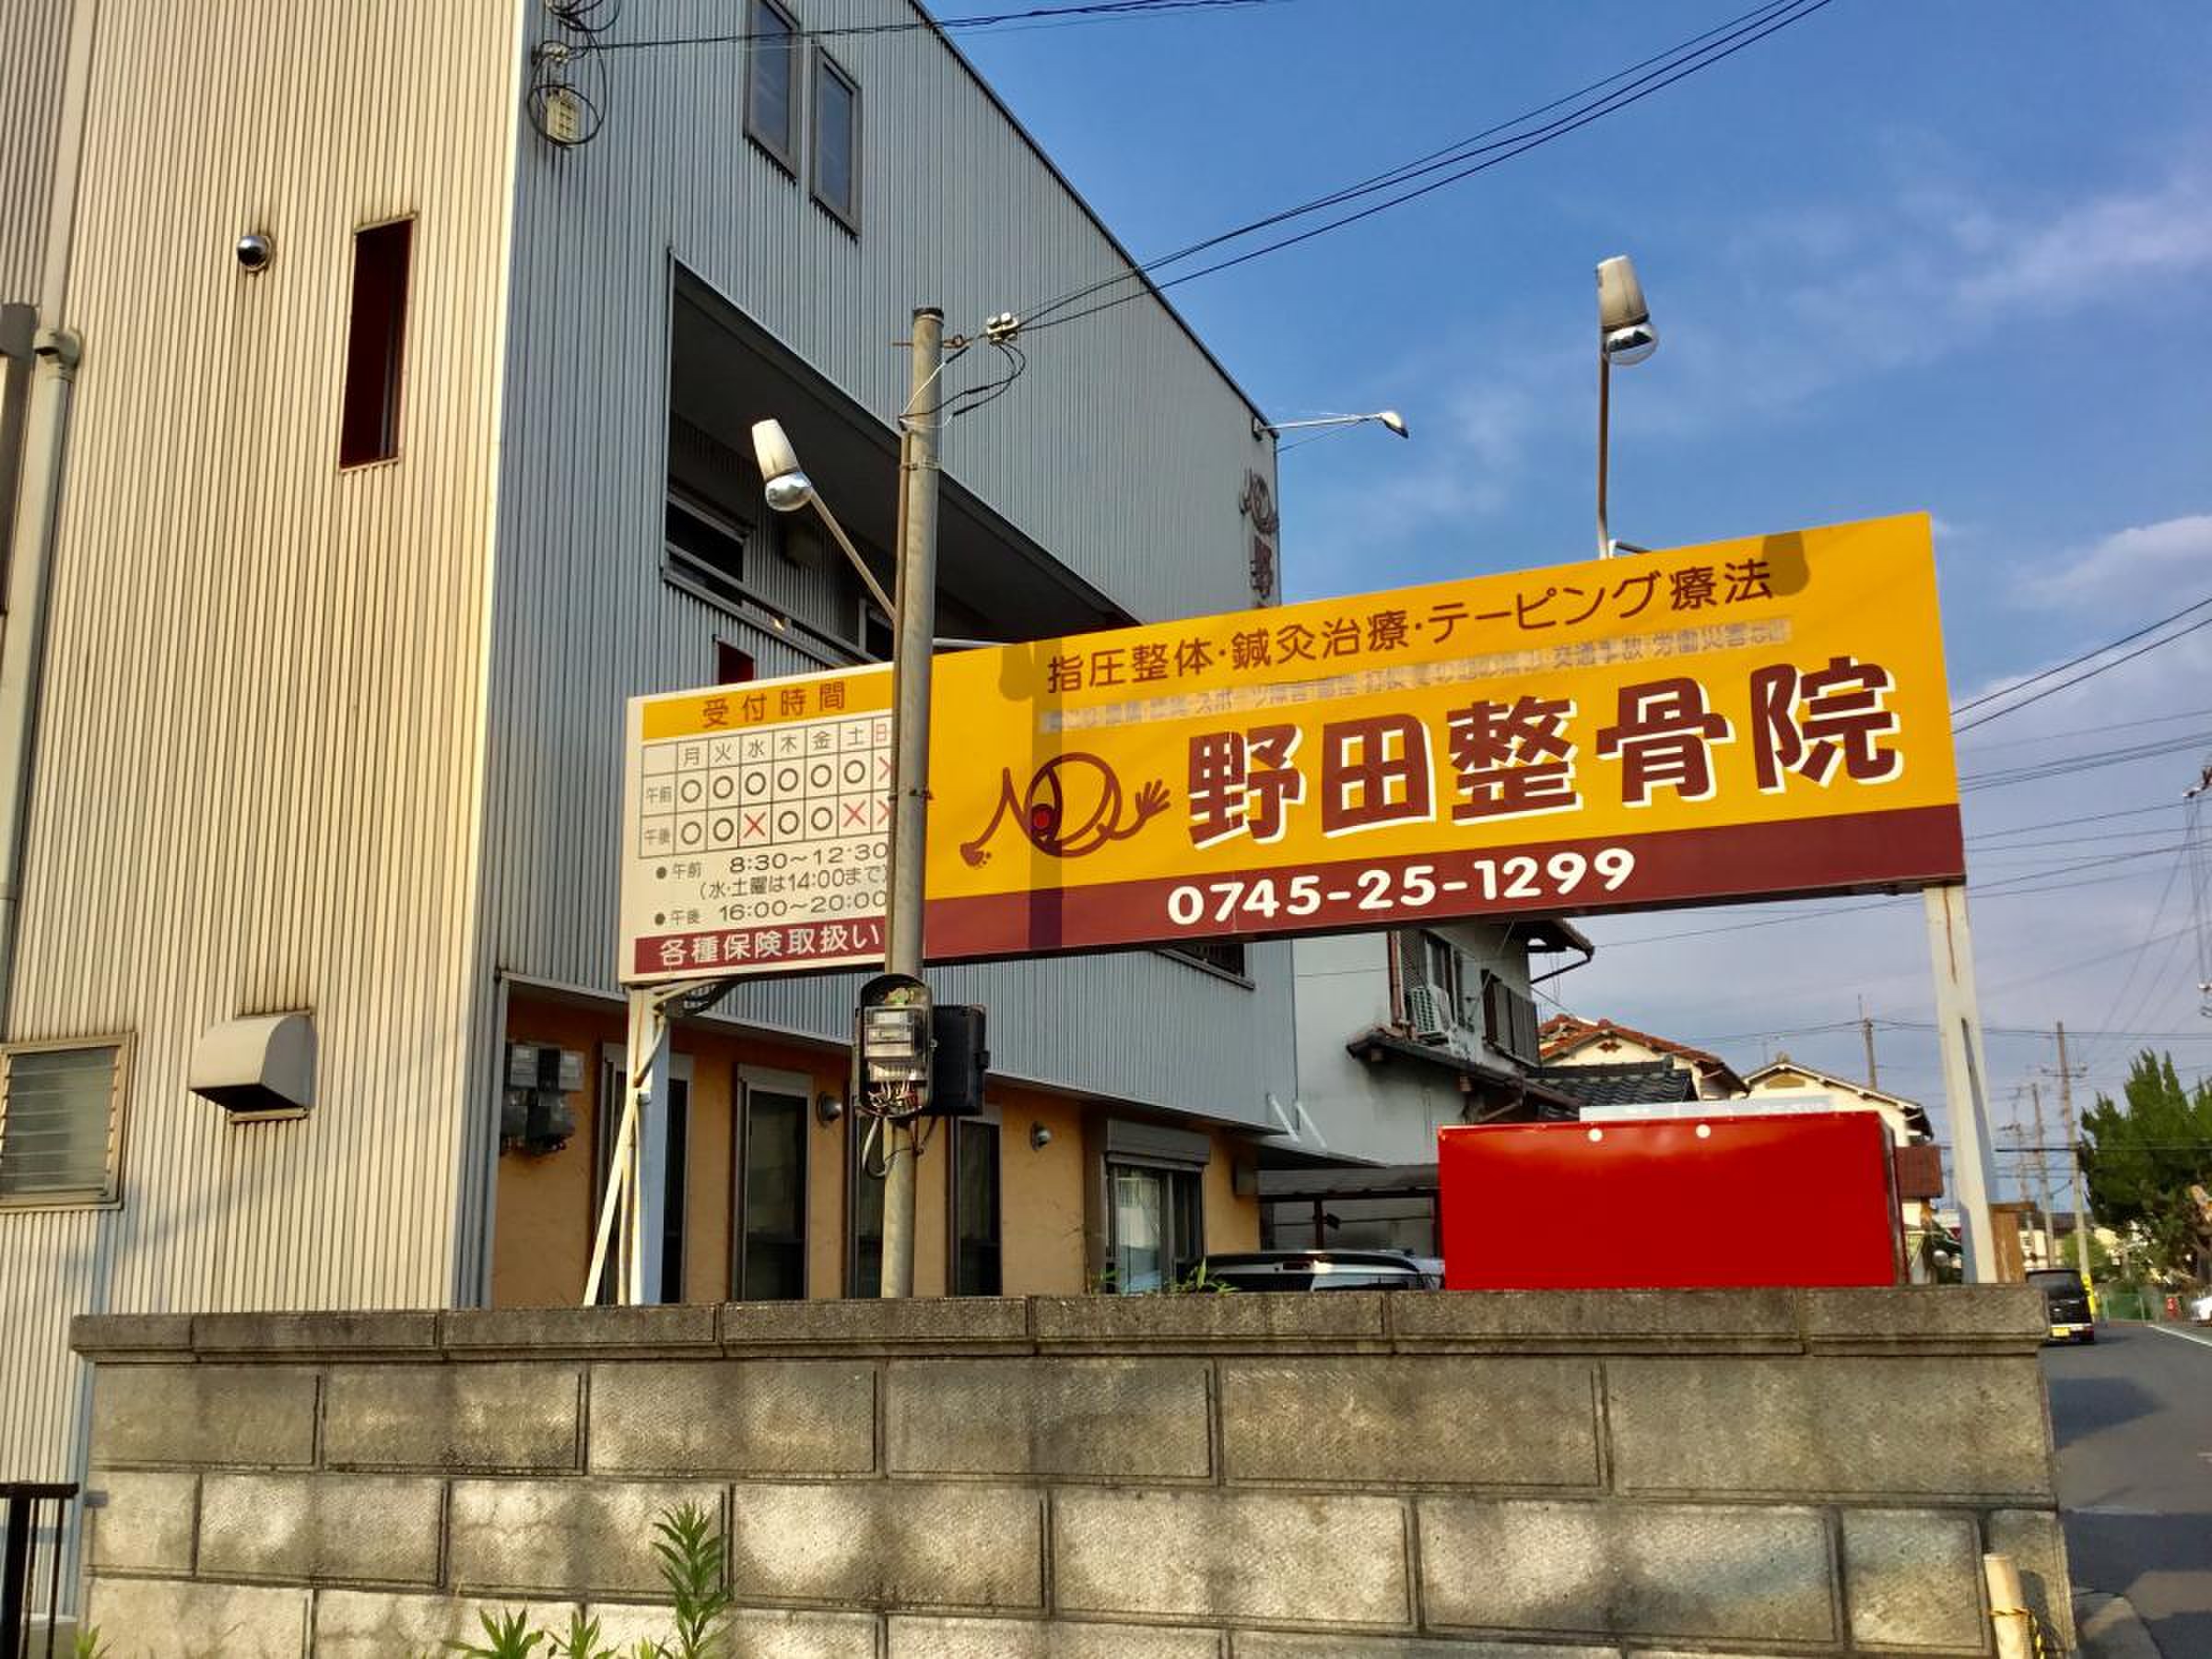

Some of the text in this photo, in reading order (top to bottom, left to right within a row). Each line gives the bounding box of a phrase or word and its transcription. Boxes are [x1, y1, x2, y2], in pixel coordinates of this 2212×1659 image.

[702, 680, 845, 729] 受付時間
[683, 747, 700, 767] 月
[715, 743, 732, 762] 火
[747, 739, 765, 758] 水
[781, 735, 797, 752] 木
[812, 731, 830, 749] 金
[847, 727, 865, 745] 土
[1187, 655, 1903, 850] 野田整骨院
[1167, 848, 1635, 924] 0745-25-1299
[660, 924, 880, 966] 各種保険取扱い
